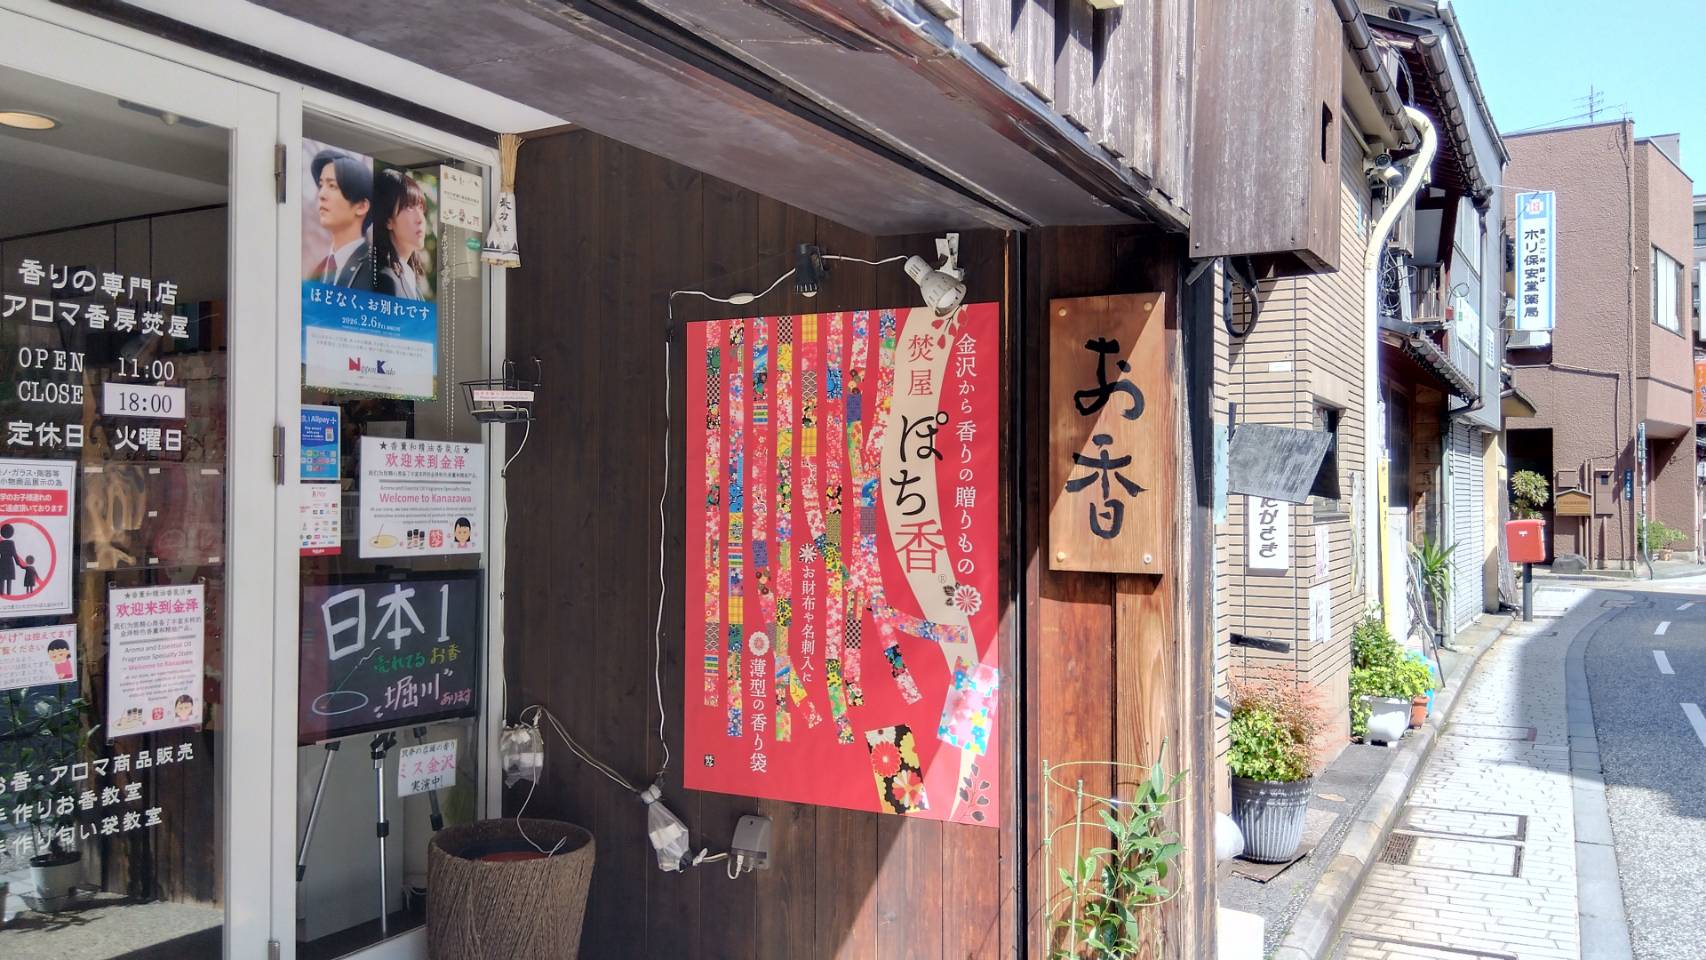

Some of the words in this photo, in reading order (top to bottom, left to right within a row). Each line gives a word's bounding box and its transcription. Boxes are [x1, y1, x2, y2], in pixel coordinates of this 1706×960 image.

[18, 258, 178, 305] 香りの専門店
[1524, 229, 1539, 318] ホリ保安堂薬局
[2, 294, 190, 338] アロマ香房焚屋
[310, 288, 430, 320] ほどなく、お別れです
[18, 347, 86, 373] OPEN
[117, 357, 175, 381] 11:00
[908, 334, 935, 397] 焚屋
[18, 380, 84, 405] CLOSE
[118, 392, 173, 413] 18:00
[7, 420, 84, 448] 定休日
[114, 425, 182, 451] 火曜日
[955, 333, 977, 574] 金沢から香りの贈りもの
[1065, 337, 1149, 539] お香
[385, 452, 466, 470] 欢迎来到金泽
[379, 493, 420, 503] Welcome
[421, 493, 430, 503] to
[431, 494, 472, 504] Kanazawa
[889, 411, 949, 574] ぽち香
[116, 597, 199, 618] 欢迎来到金泽
[321, 584, 450, 661] 日本1
[801, 567, 816, 683] お財布や名刺入に
[749, 658, 768, 773] 薄型の香り袋
